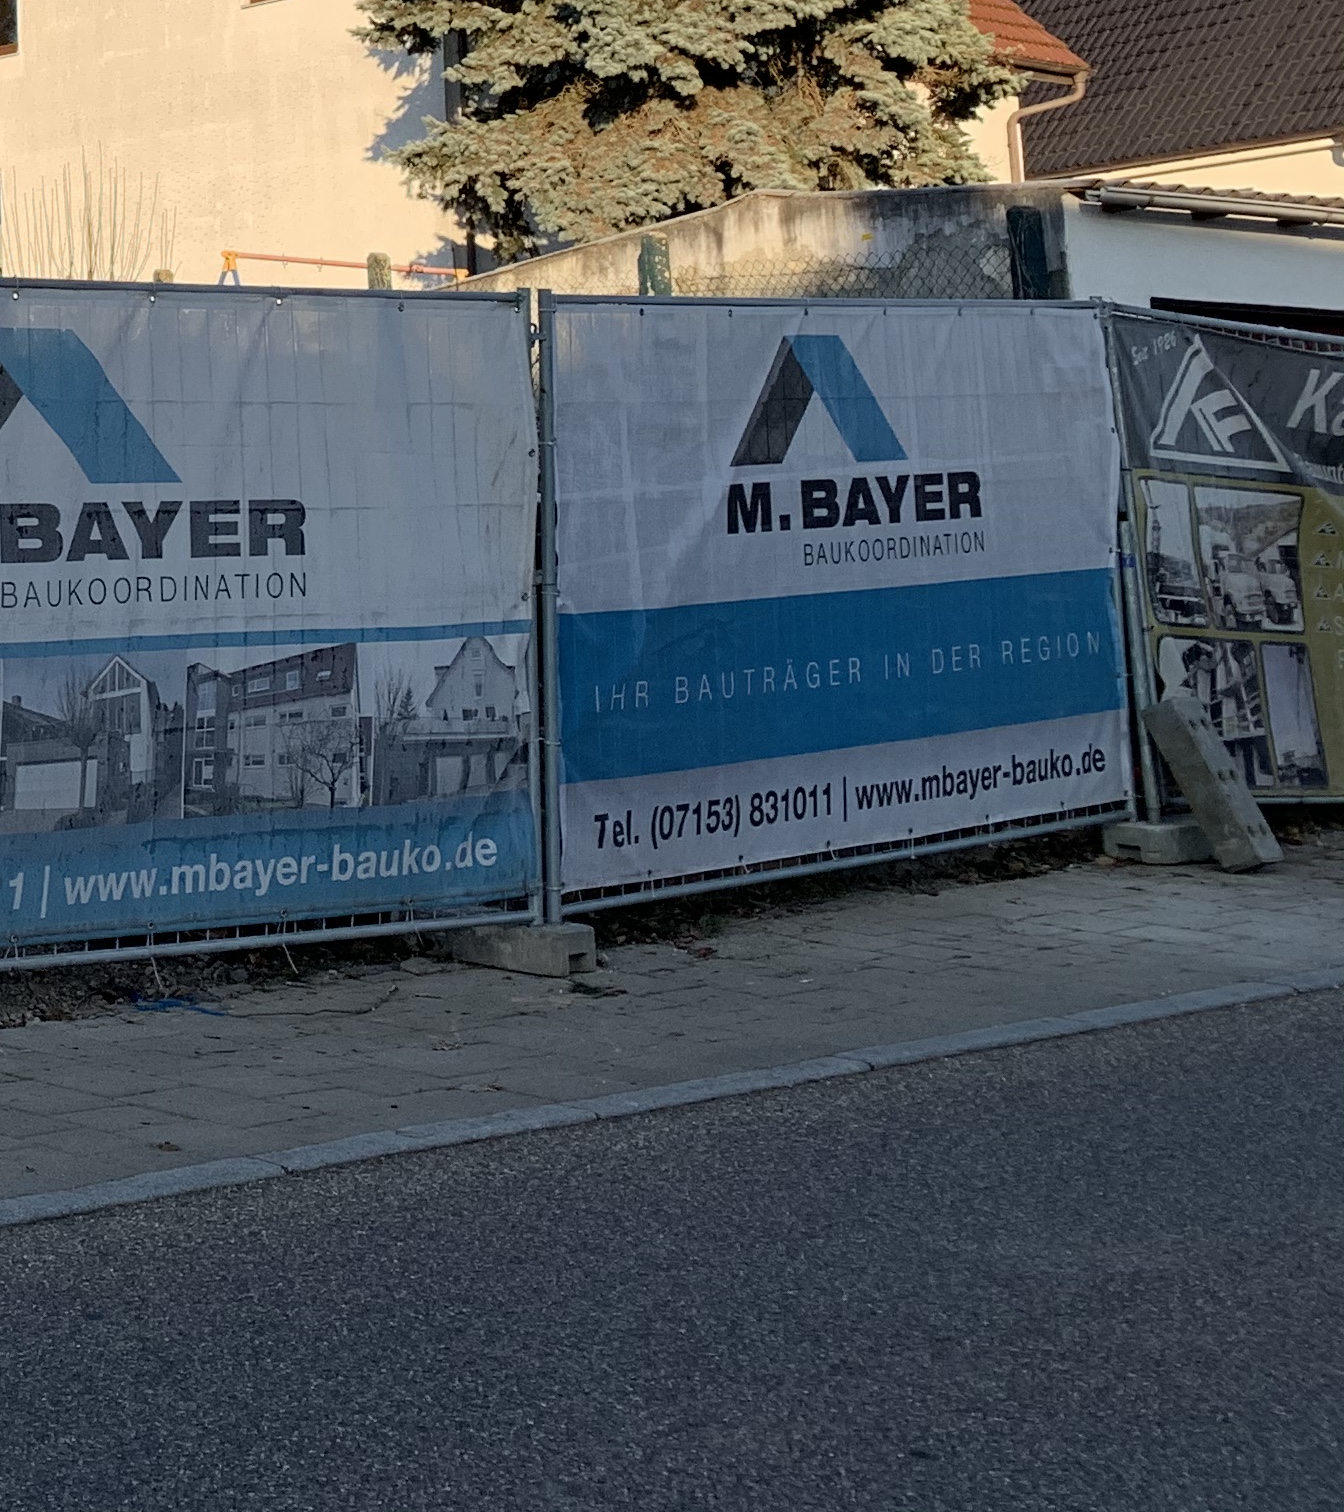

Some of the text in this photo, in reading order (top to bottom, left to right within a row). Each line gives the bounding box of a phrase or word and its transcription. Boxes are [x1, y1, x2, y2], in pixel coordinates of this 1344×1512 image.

[803, 530, 986, 567] BAUKOORDINATION
[0, 572, 308, 609] BAUKOORDINATION
[594, 631, 1102, 713] IHR BAUTRÄGER IN DER REGION
[593, 810, 640, 850] Tel.
[650, 794, 742, 850] (07153)
[749, 782, 833, 828] 831011
[854, 743, 1107, 811] www.mbayer-bauko.de
[64, 831, 499, 906] www.mbayer-bauko.de
